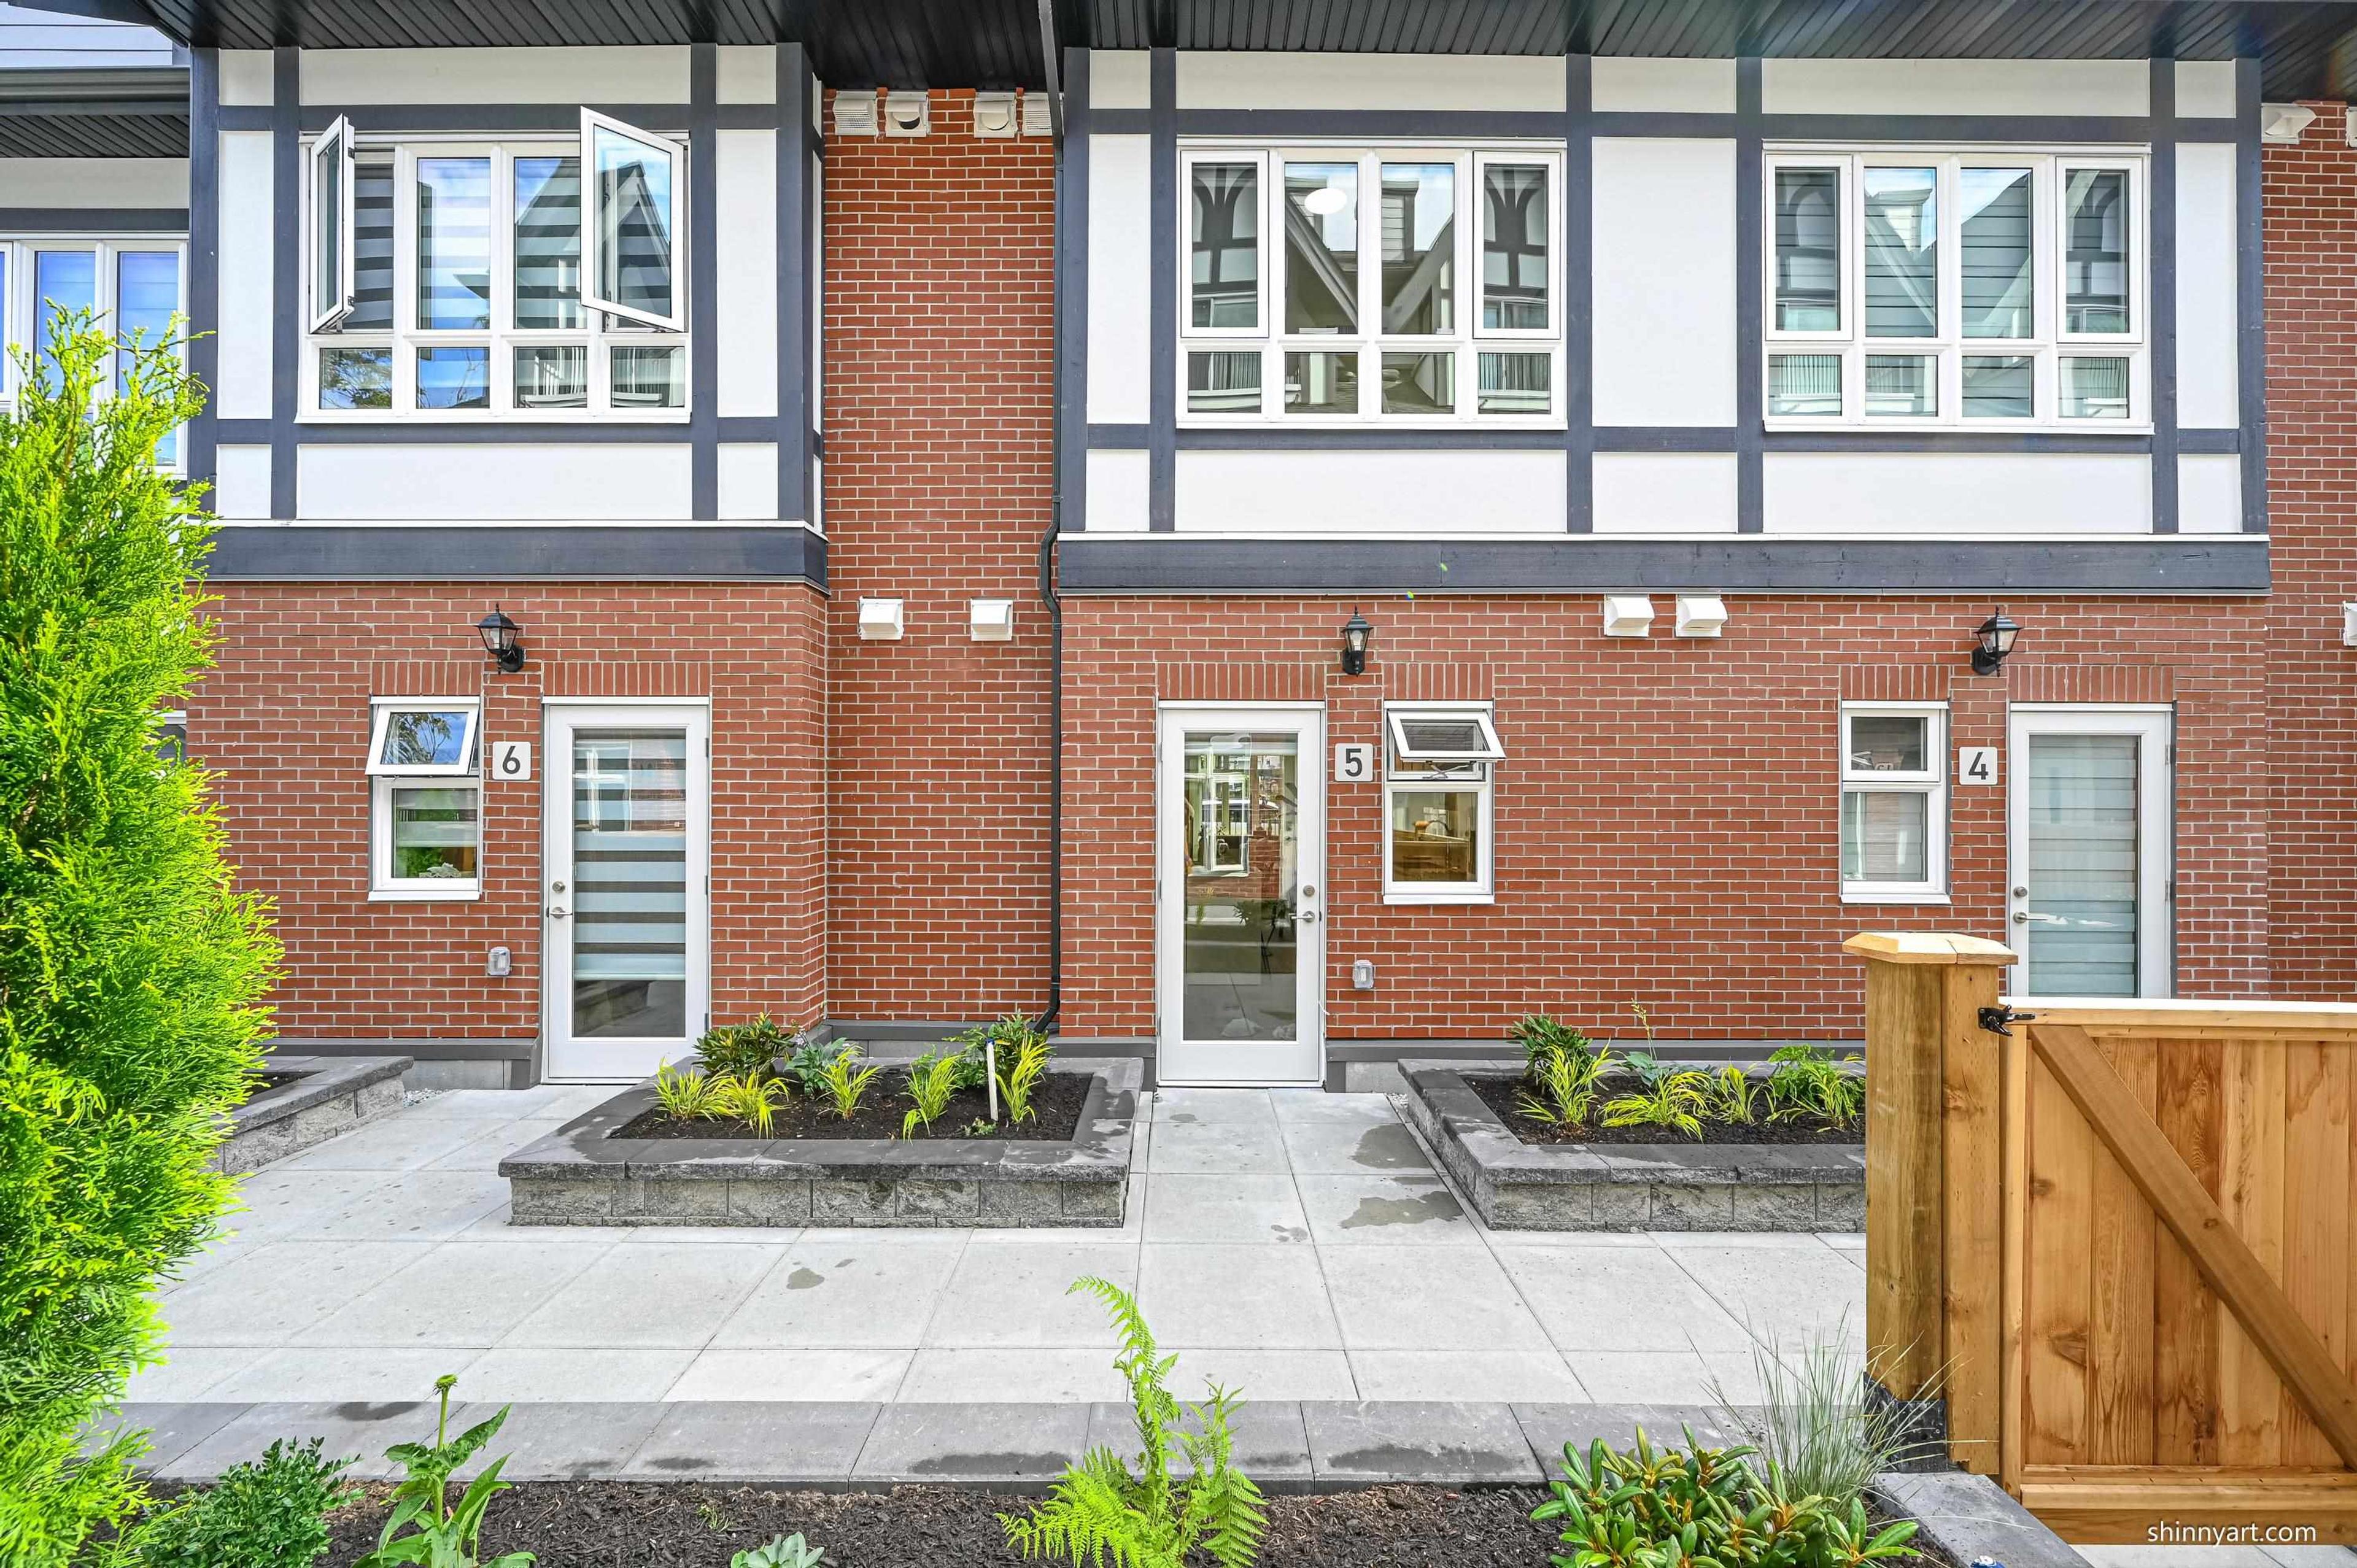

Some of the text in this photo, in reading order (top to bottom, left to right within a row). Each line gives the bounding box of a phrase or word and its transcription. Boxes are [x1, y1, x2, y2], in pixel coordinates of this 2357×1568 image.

[502, 745, 521, 774] 6
[1345, 748, 1363, 777] 5
[1968, 751, 1988, 780] 4
